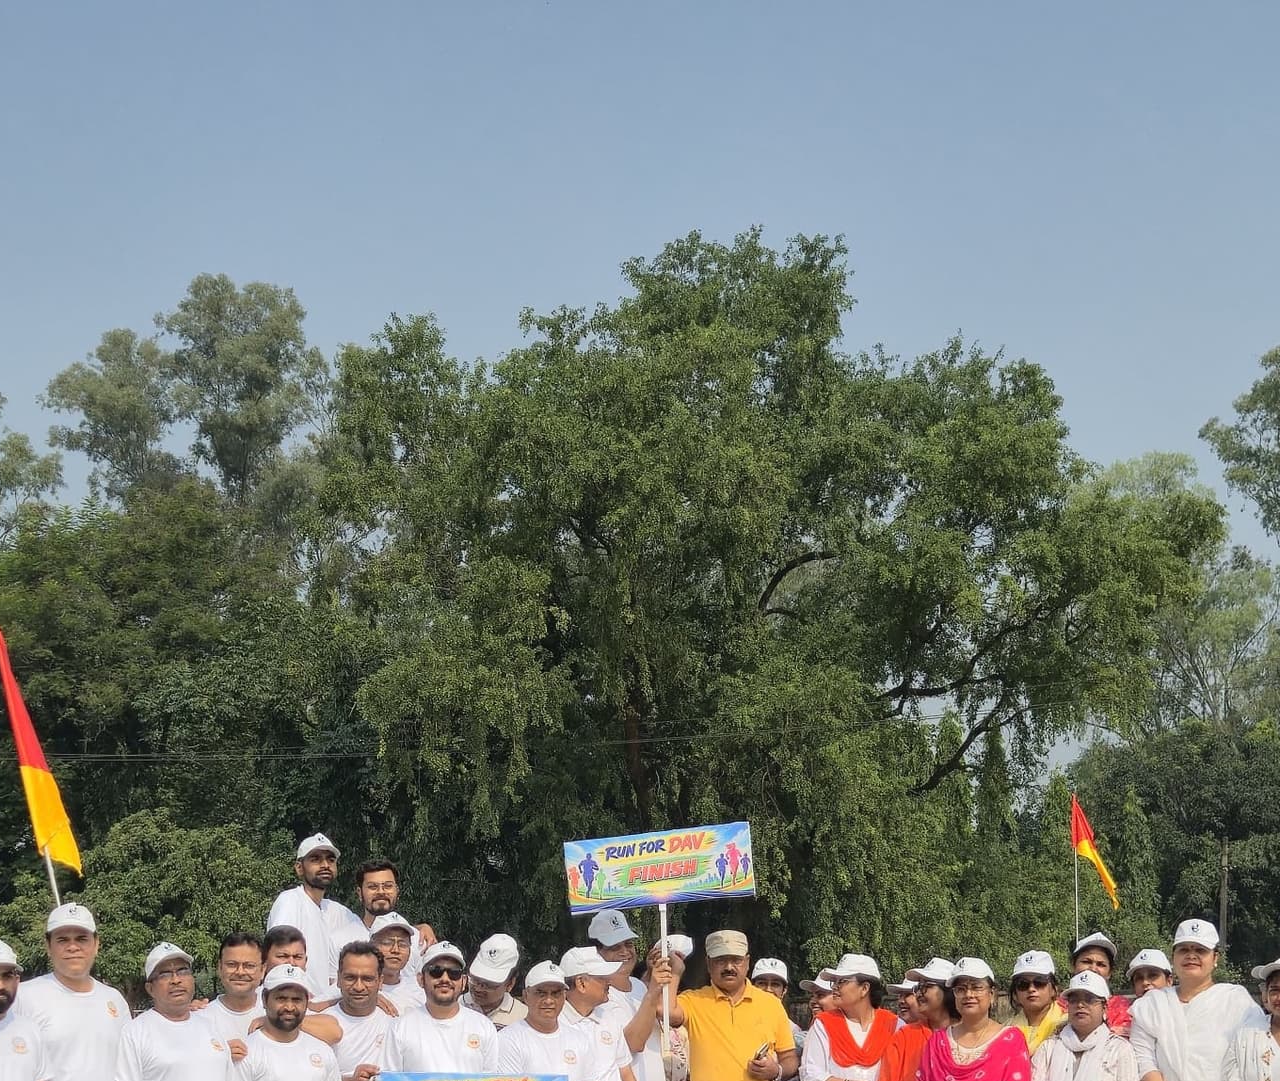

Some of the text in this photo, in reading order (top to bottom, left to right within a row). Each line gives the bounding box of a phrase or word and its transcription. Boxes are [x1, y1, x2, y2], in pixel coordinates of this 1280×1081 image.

[605, 832, 705, 861] RUN FOR DAV
[628, 859, 697, 884] FINISH
